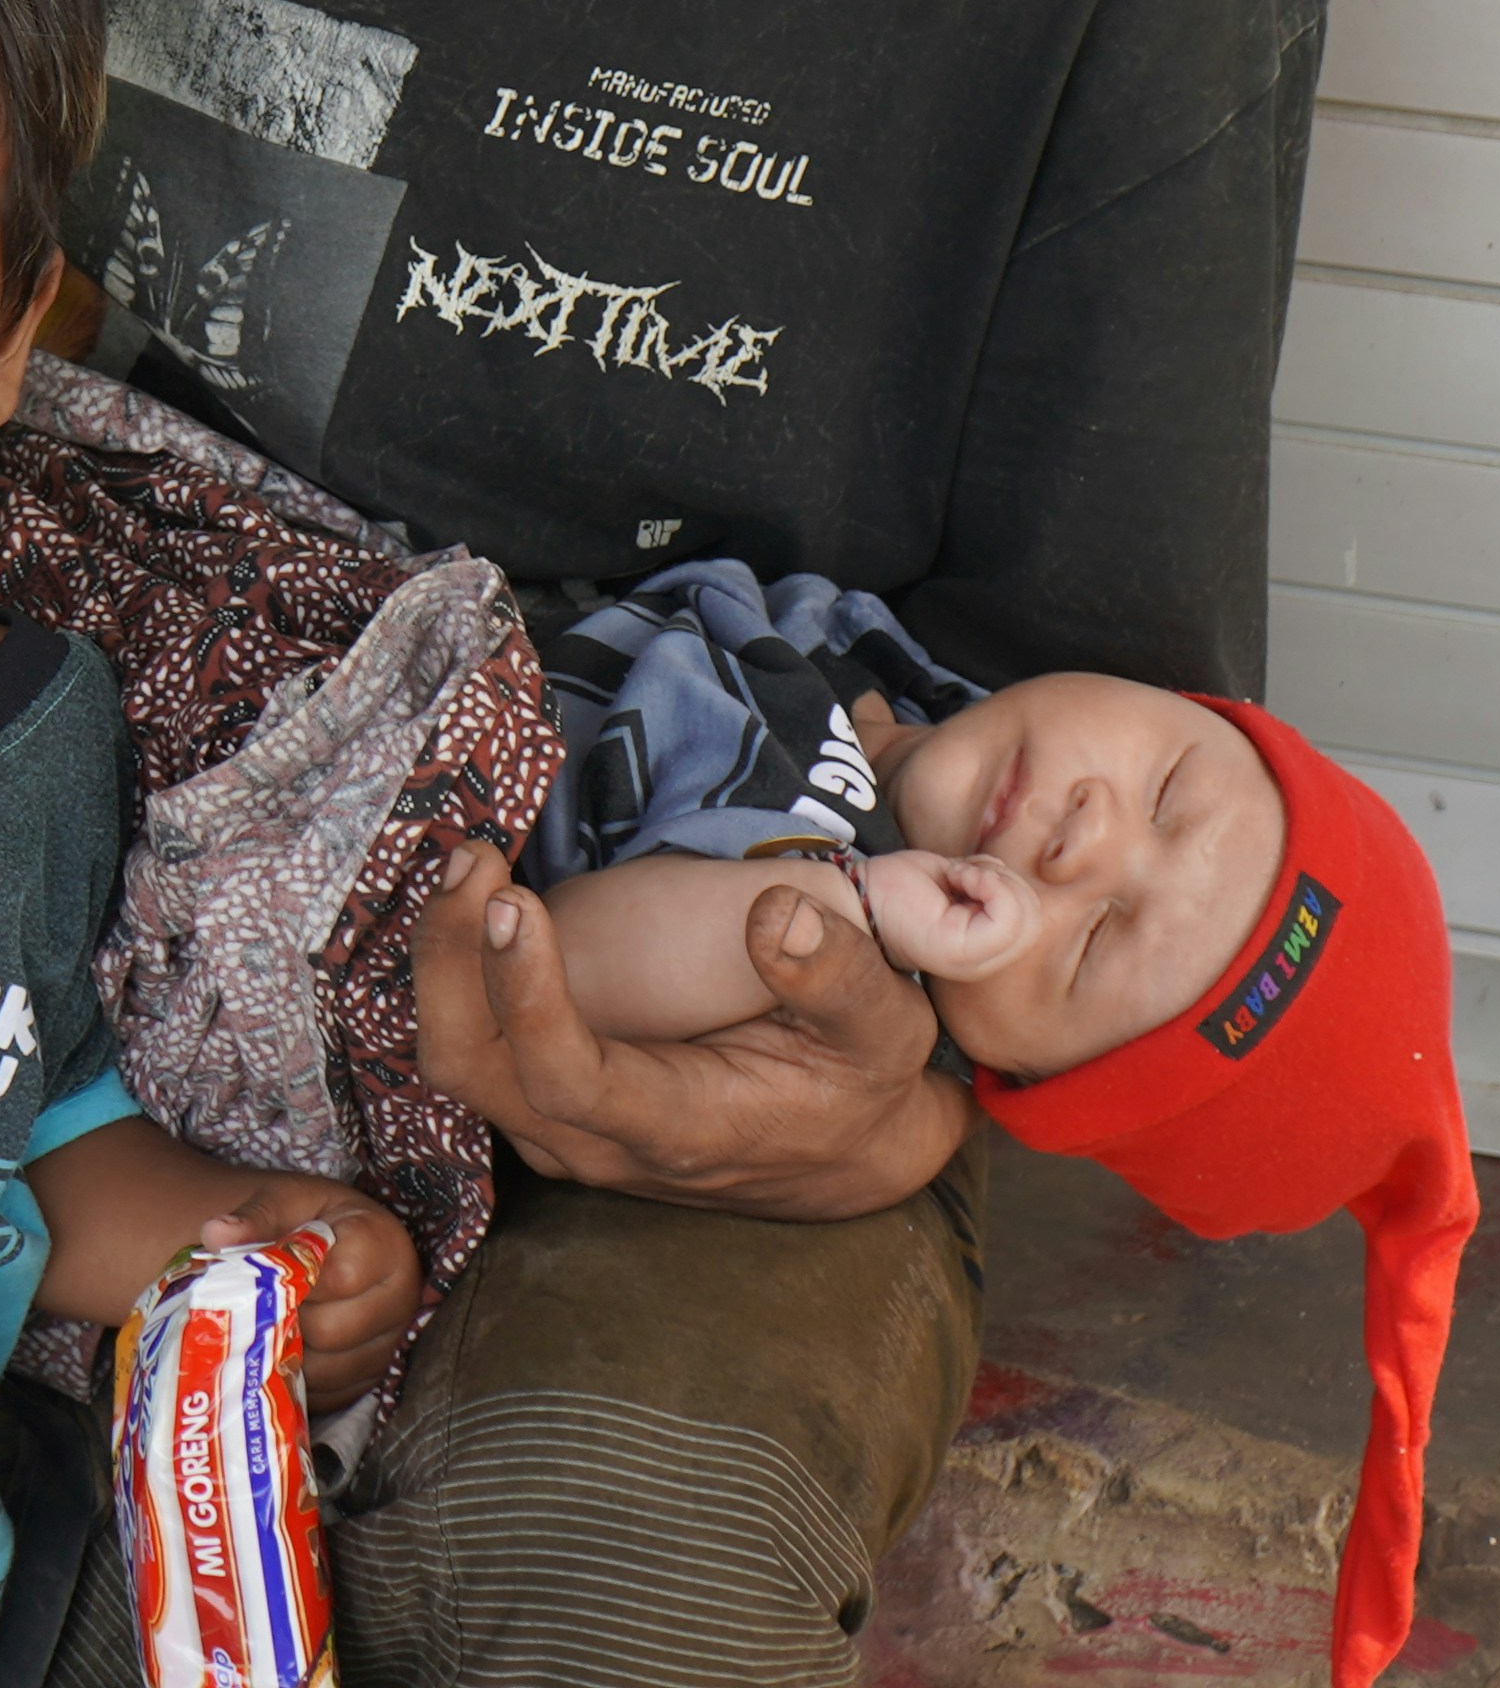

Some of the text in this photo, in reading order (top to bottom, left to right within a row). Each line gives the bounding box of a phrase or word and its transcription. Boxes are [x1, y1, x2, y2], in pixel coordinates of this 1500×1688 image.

[483, 87, 814, 207] INSIDE SOUL
[1223, 886, 1322, 1045] AZMI BABY
[182, 1389, 227, 1579] MI GORENG
[247, 1356, 267, 1475] CARA MEMASAK
